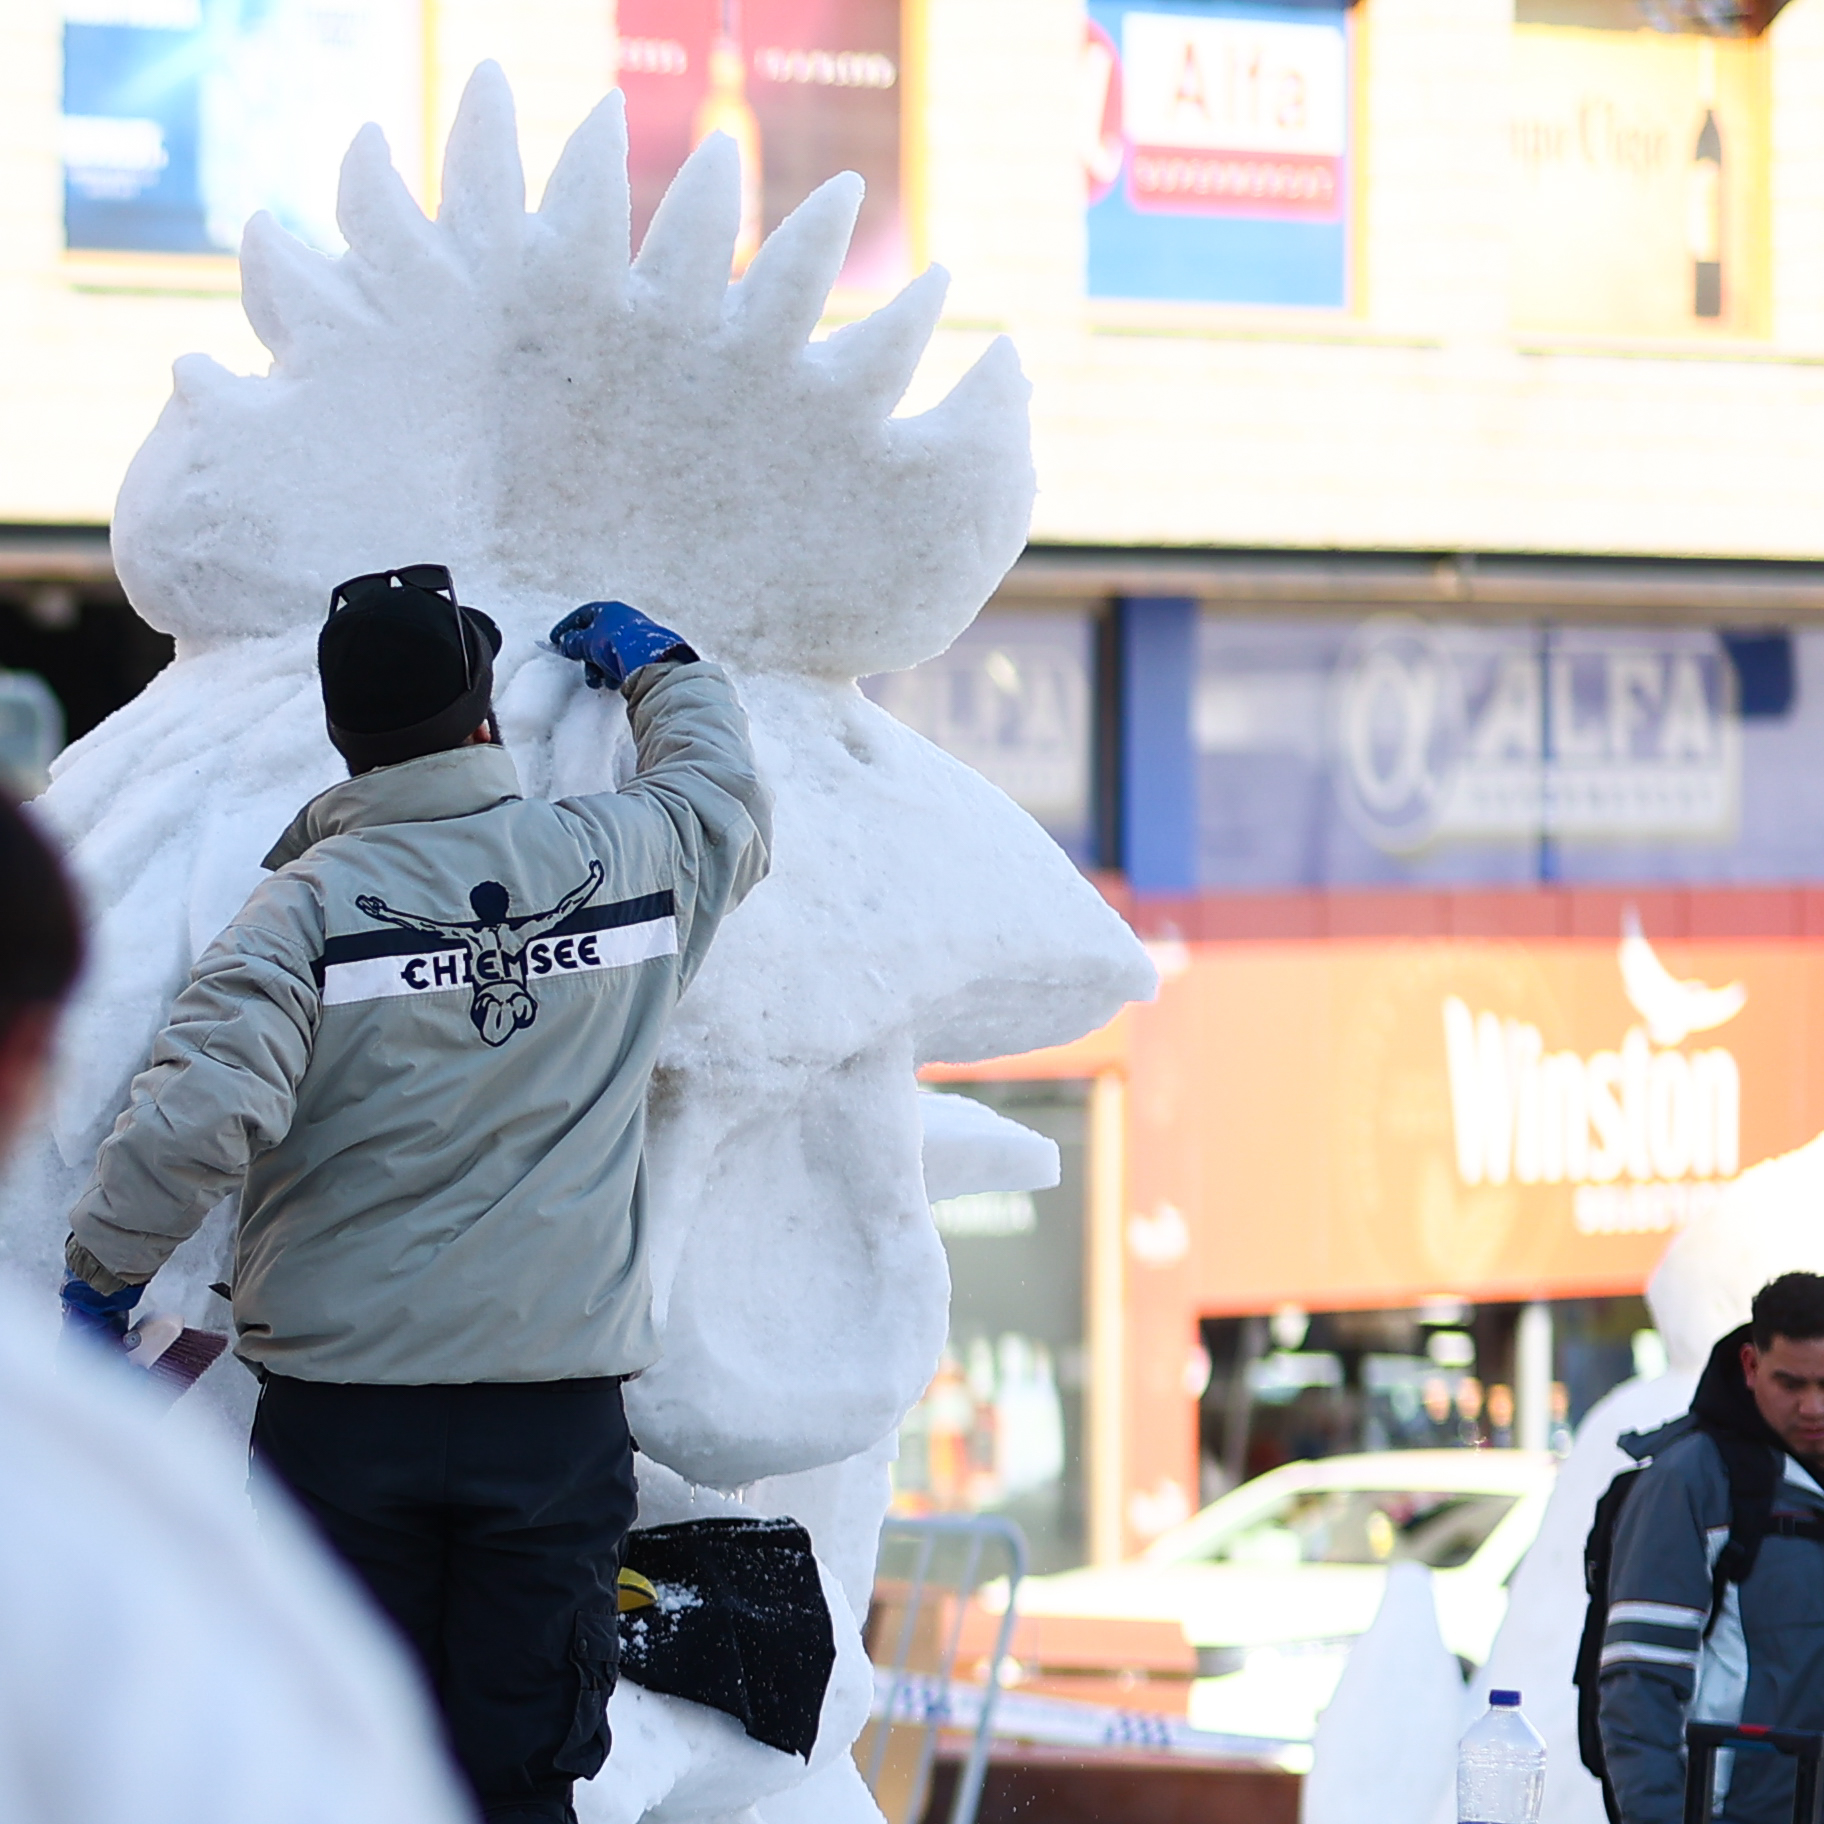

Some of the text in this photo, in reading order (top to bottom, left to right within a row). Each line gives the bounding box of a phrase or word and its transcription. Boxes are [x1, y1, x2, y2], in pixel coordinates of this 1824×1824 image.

[1163, 40, 1309, 130] Alfa
[1466, 650, 1718, 760] ALFA
[400, 934, 601, 990] CHIEMSEE
[1441, 993, 1741, 1185] Winston
